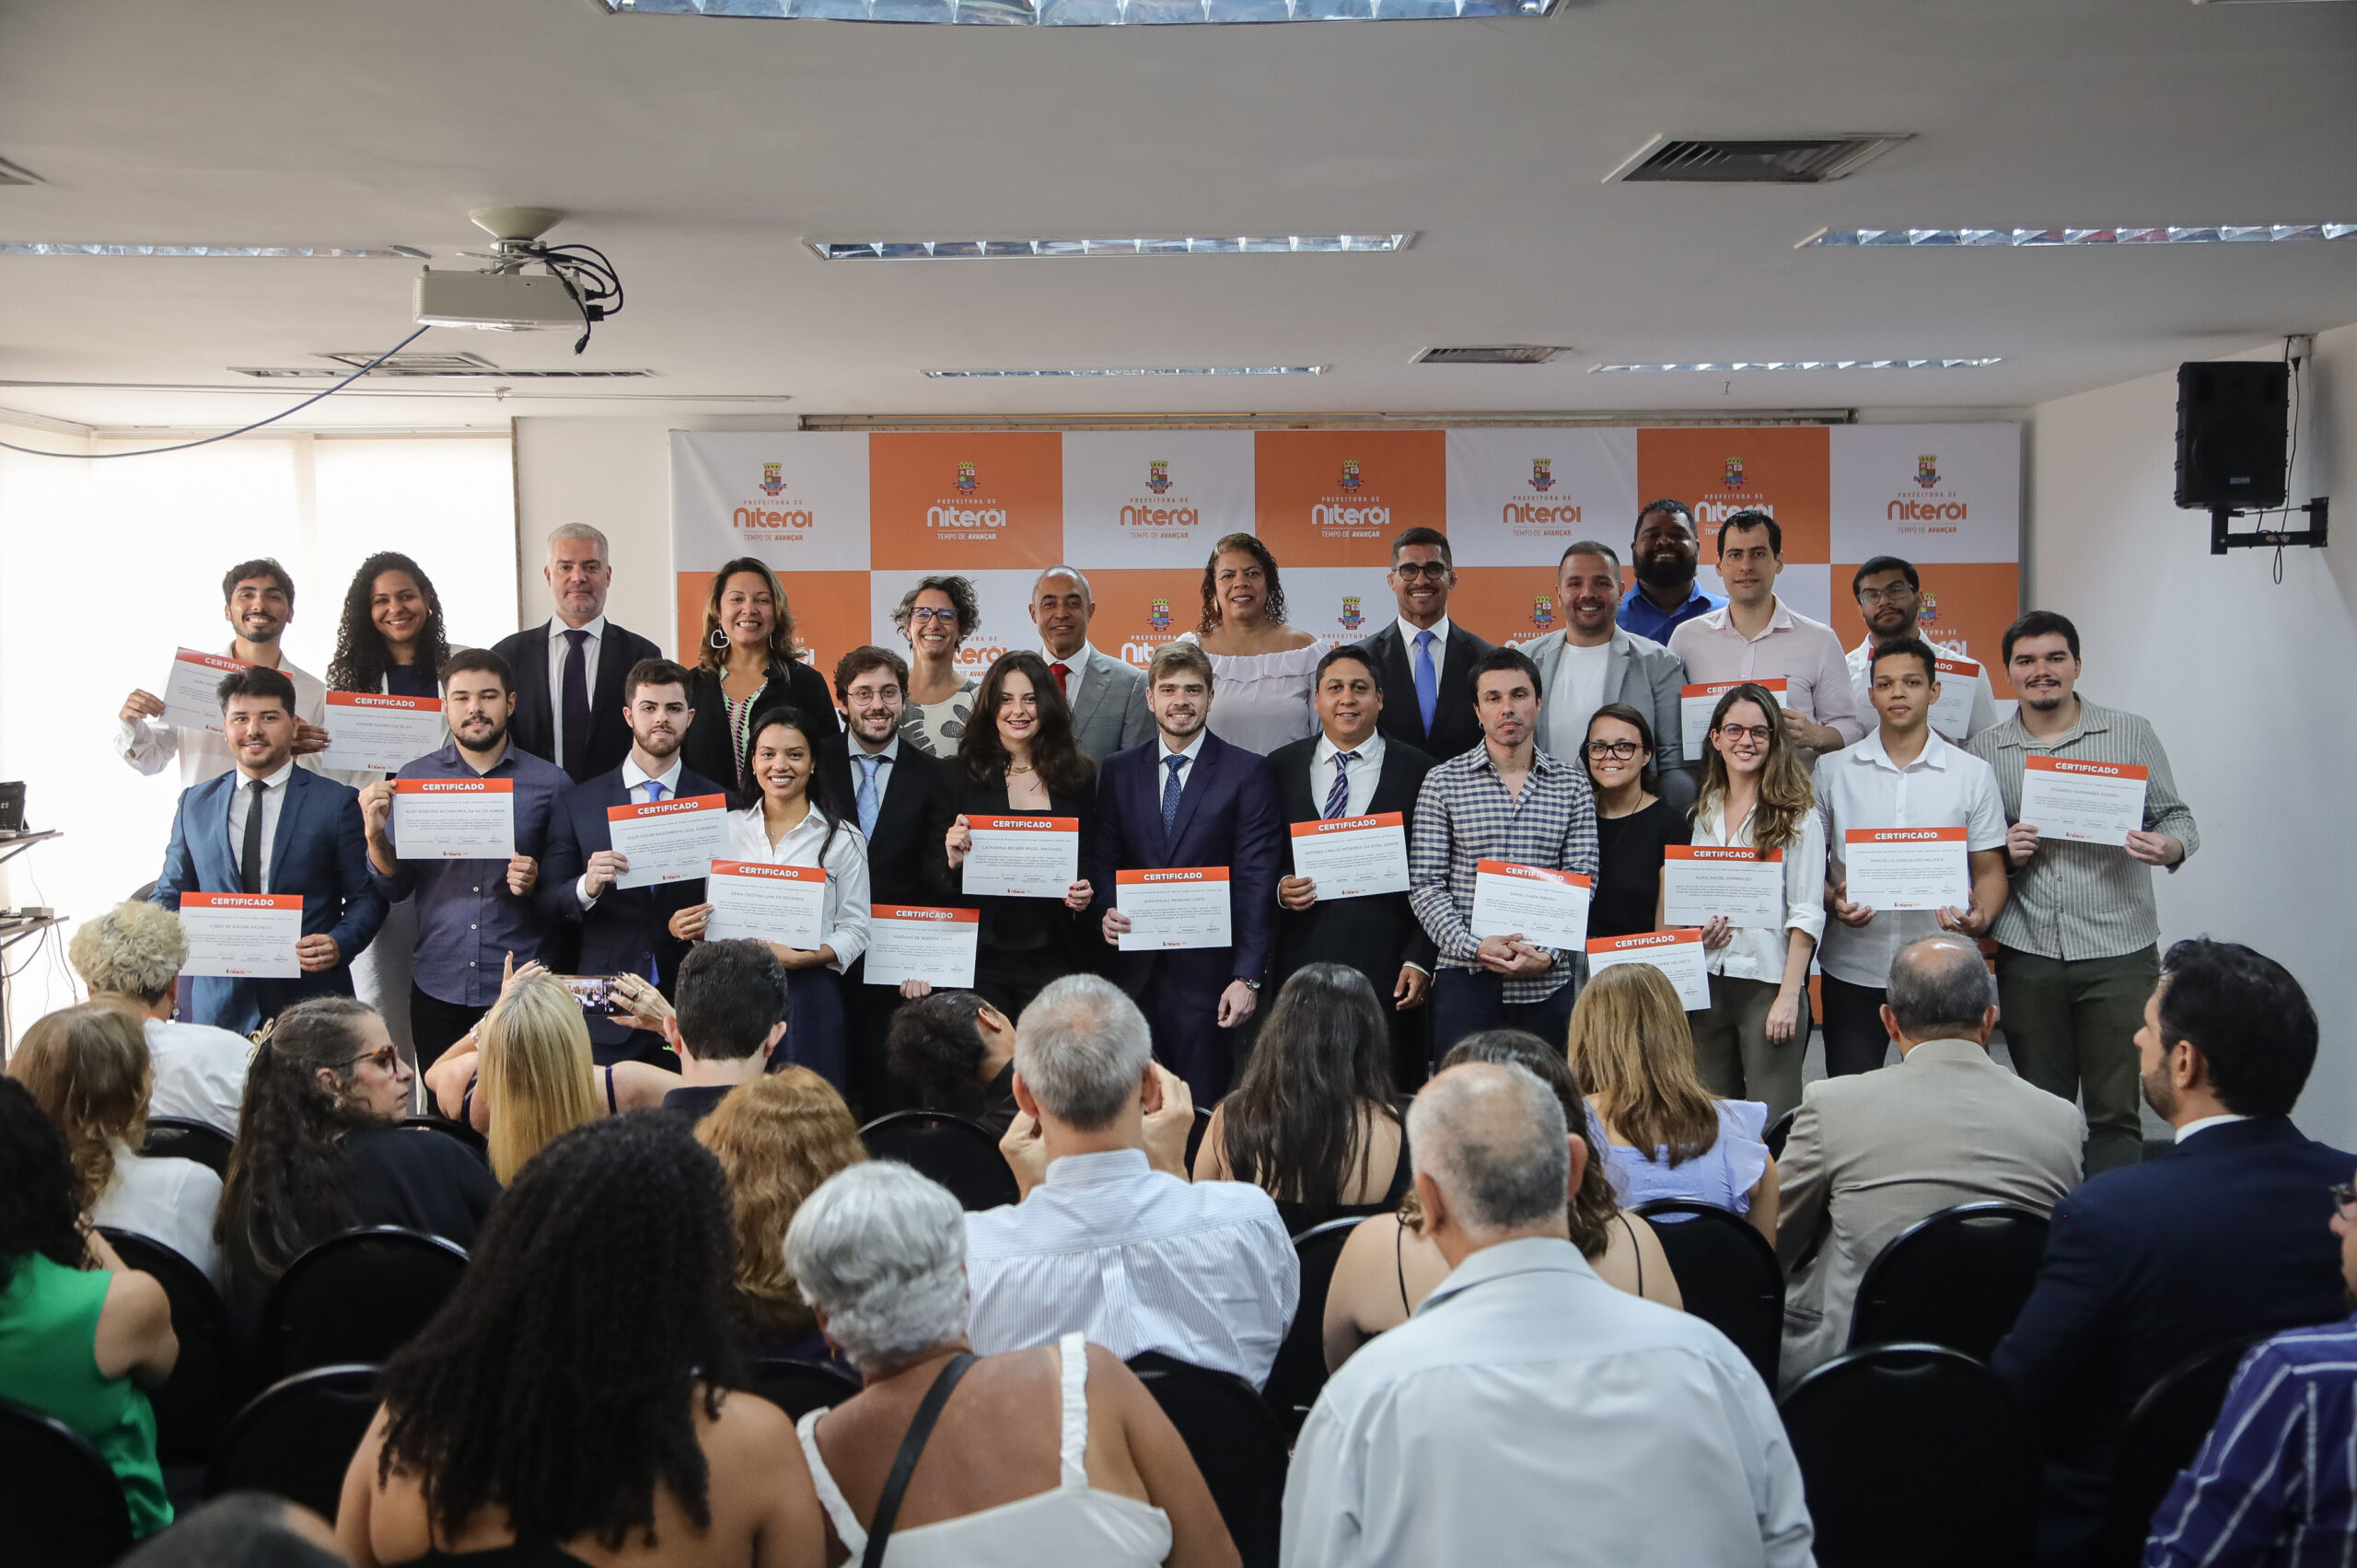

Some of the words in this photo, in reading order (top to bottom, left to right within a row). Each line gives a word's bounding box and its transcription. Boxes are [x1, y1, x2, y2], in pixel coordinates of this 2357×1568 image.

[204, 657, 246, 672] CERTIFIC
[354, 697, 416, 708] CERTIFICADO
[2055, 762, 2119, 775] CERTIFICADO
[422, 783, 485, 791] CERTIFICADO
[637, 801, 699, 815] CERTIFICADO
[993, 820, 1053, 829] CERTIFICADO
[1318, 819, 1377, 831] CERTIFICADO
[1875, 831, 1938, 840] CERTIFICADO
[1694, 850, 1755, 859] CERTIFICADO
[738, 866, 800, 877] CERTIFICADO
[1144, 872, 1203, 881] CERTIFICADO
[210, 897, 275, 906] CERTIFICADO
[895, 910, 954, 919] CERTIFICADO
[1615, 935, 1675, 948] CERTIFICADO
